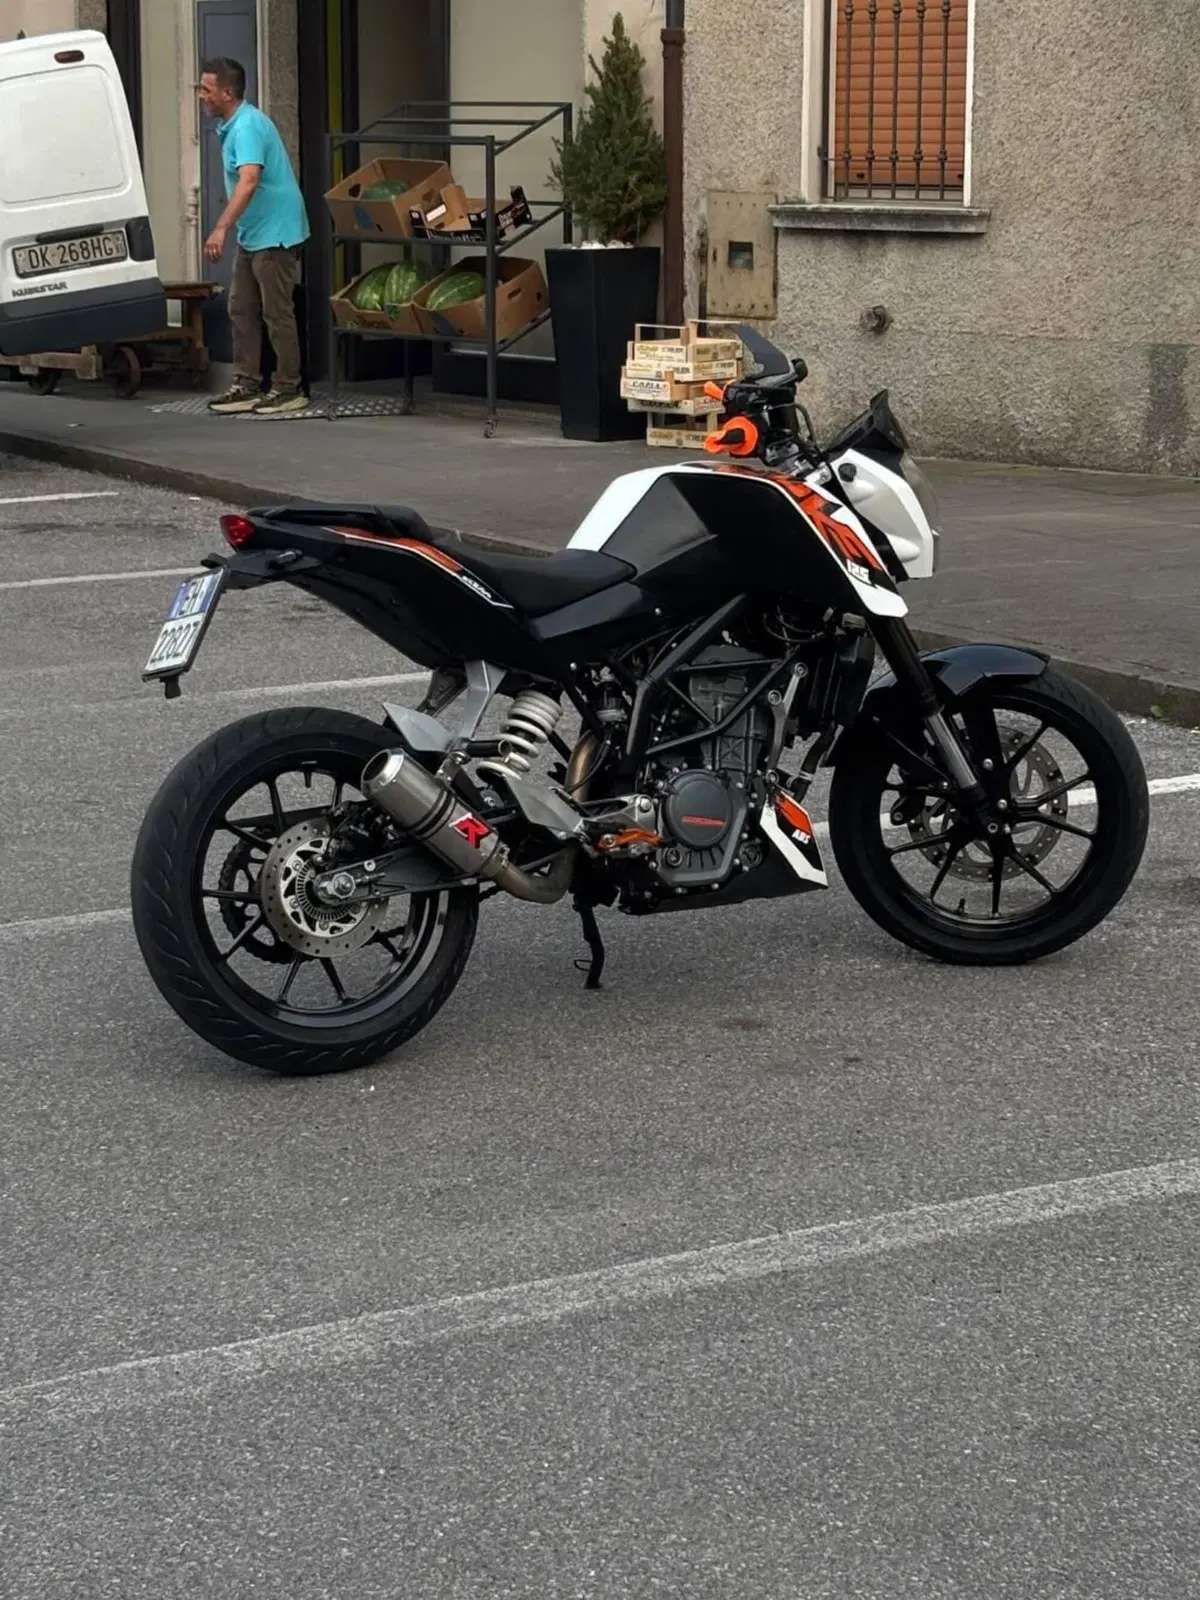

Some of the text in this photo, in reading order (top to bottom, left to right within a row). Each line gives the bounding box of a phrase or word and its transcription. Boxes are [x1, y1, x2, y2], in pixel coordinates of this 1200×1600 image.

[28, 236, 114, 269] DK 268HG
[792, 829, 811, 844] ABS
